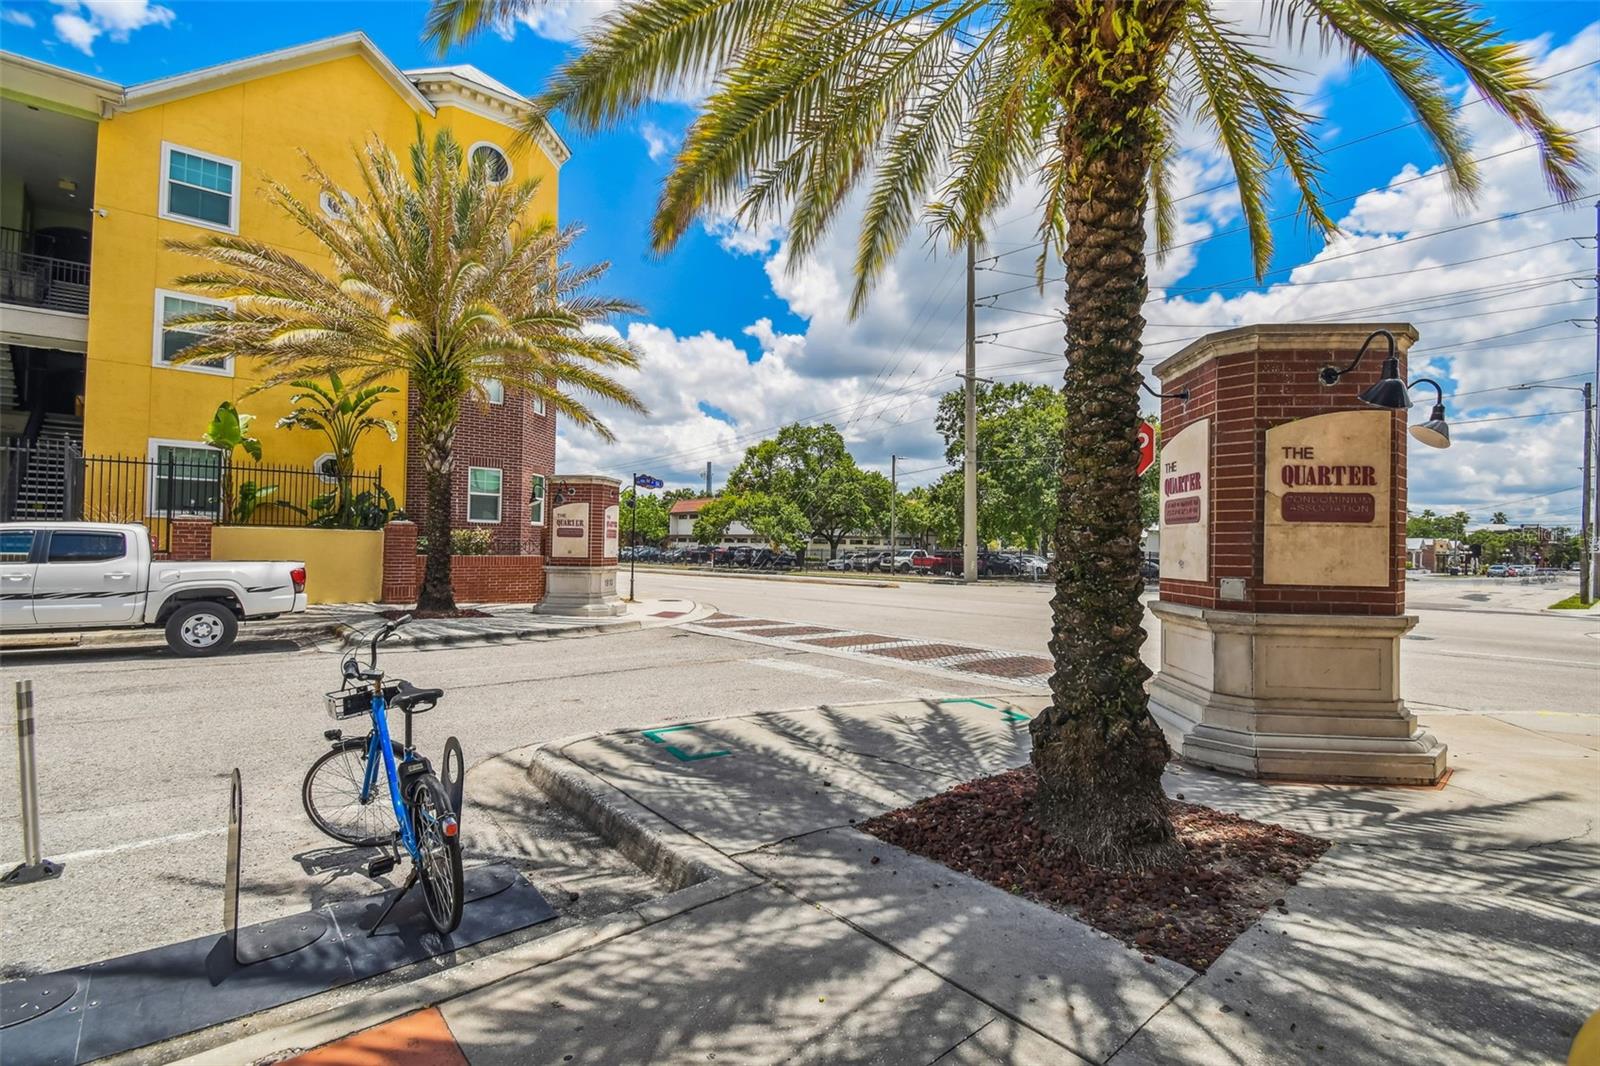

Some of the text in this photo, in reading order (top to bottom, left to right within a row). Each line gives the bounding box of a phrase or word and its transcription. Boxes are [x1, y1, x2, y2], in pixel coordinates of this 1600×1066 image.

[1282, 447, 1314, 460] THE
[1165, 461, 1177, 473] THE
[1164, 472, 1201, 496] QUARTER
[1281, 465, 1378, 487] QUARTER
